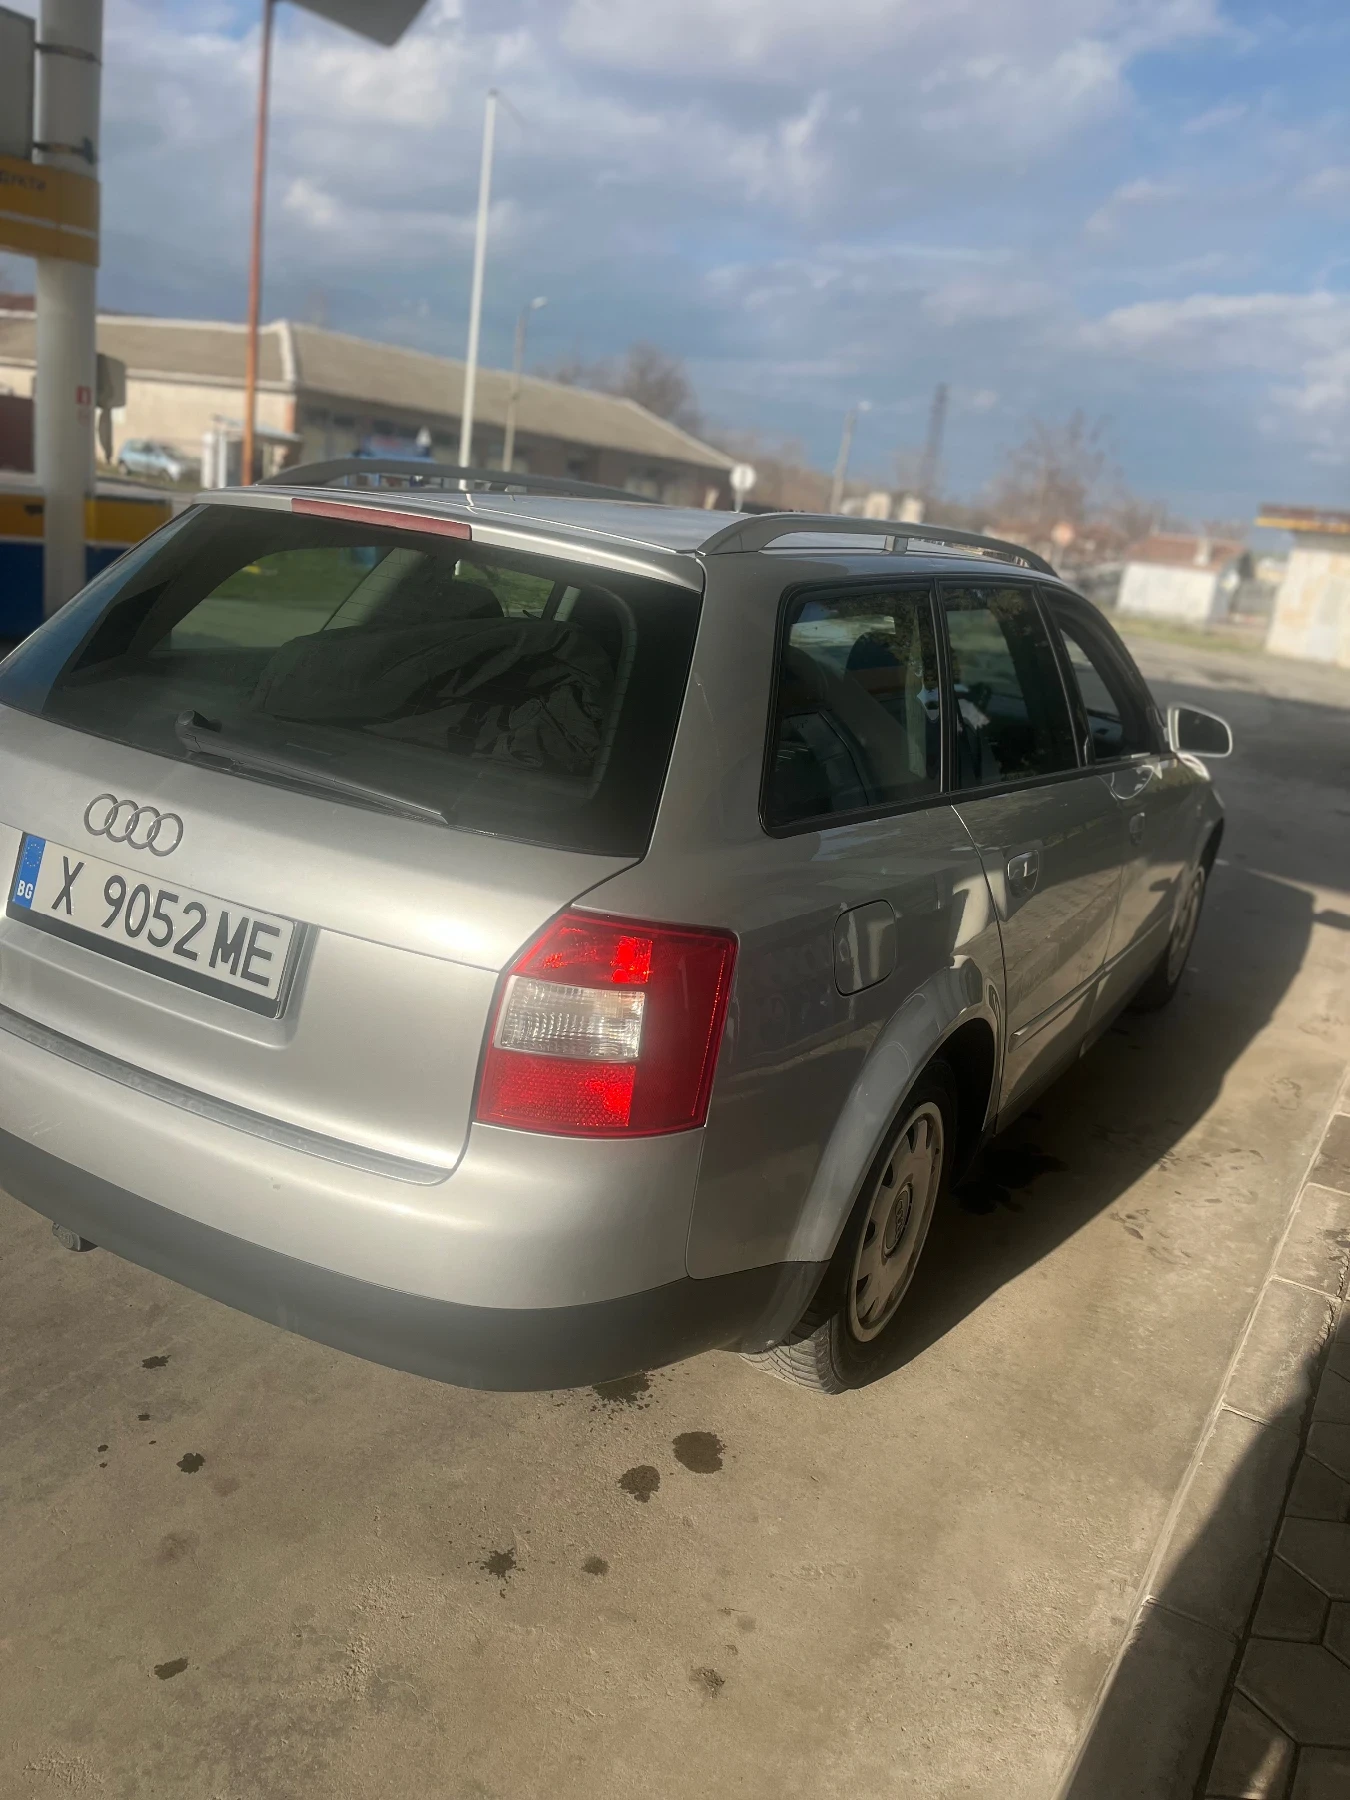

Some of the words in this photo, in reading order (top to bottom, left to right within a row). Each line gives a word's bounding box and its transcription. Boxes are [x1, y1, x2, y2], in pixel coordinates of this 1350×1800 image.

[17, 880, 34, 899] BG
[51, 856, 85, 915] X
[101, 875, 207, 961] 9052
[209, 911, 281, 987] ME
